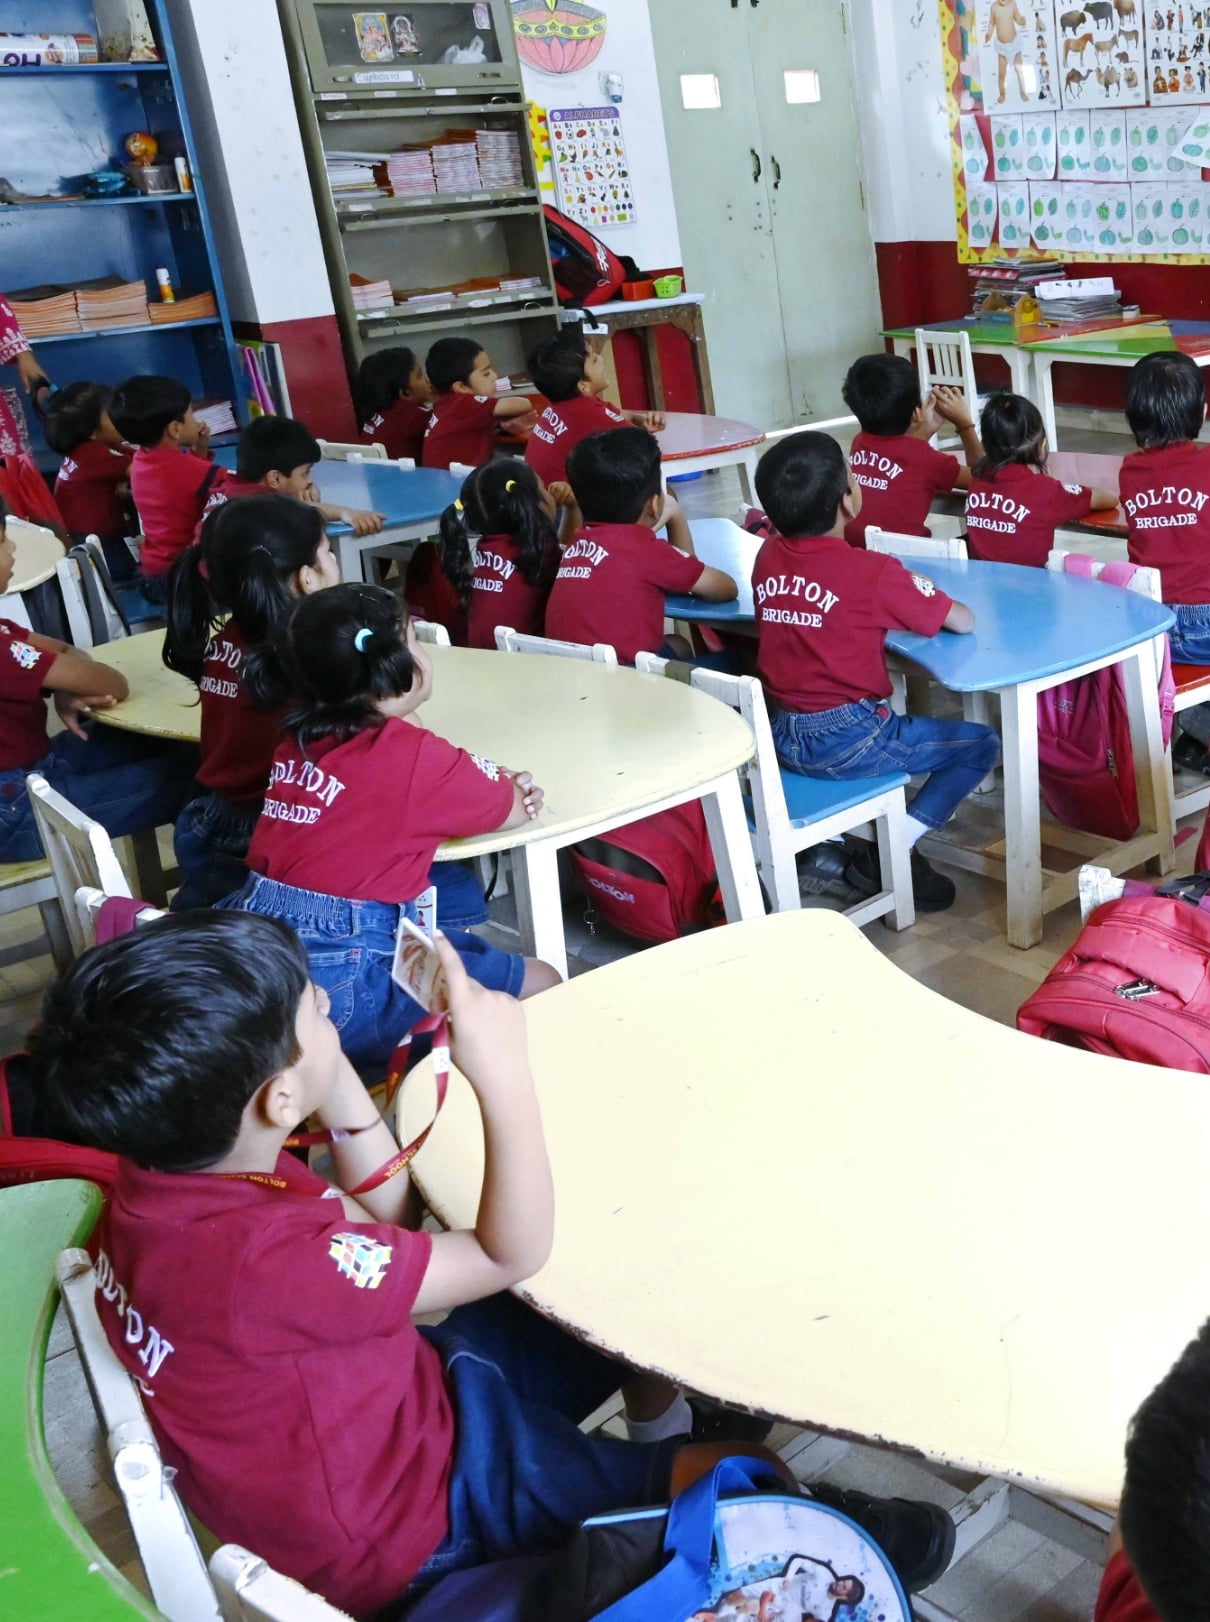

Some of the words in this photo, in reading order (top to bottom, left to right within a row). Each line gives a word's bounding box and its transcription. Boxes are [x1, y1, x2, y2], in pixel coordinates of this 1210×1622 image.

[565, 110, 615, 120] ALPHABETS
[1124, 486, 1210, 517] BOLTON
[966, 515, 1017, 534] BRIGADE
[1135, 513, 1198, 529] BRIGADE
[562, 539, 609, 566] OLTON
[756, 574, 840, 614] BOLTON
[761, 607, 823, 628] BRIGADE
